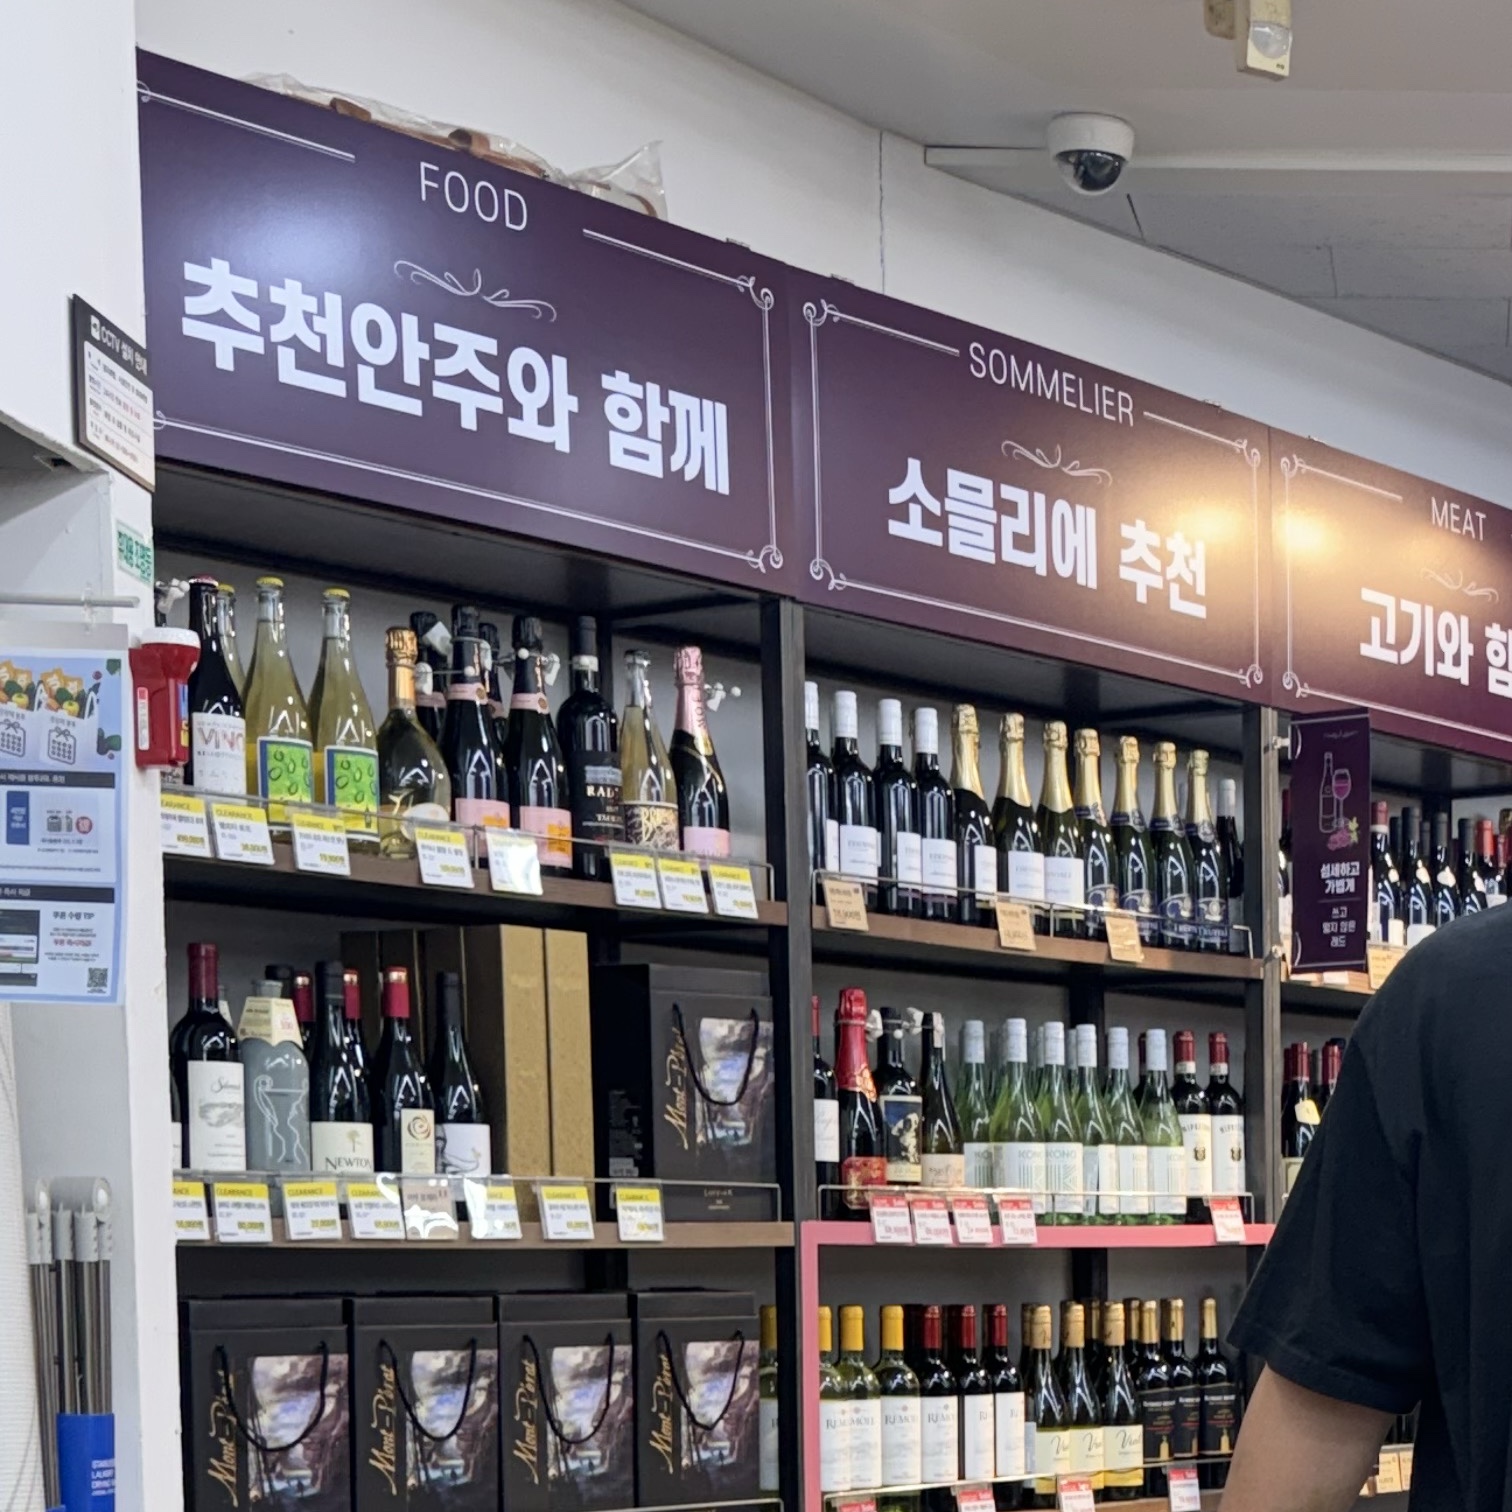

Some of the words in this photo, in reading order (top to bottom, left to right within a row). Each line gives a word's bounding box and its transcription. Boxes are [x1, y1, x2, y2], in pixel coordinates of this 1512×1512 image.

[418, 161, 529, 232] FOOD
[101, 325, 120, 353] CCTV
[181, 257, 577, 453] 추천안주와
[601, 369, 731, 496] 함께
[968, 342, 1135, 427] SOMMELIER
[887, 456, 1098, 590] 소믈리에
[1117, 520, 1207, 619] 추천
[1430, 496, 1487, 541] MEAT
[1360, 588, 1474, 687] 고기와
[1321, 861, 1360, 879] 섬세하고
[1325, 878, 1355, 894] 가볍게
